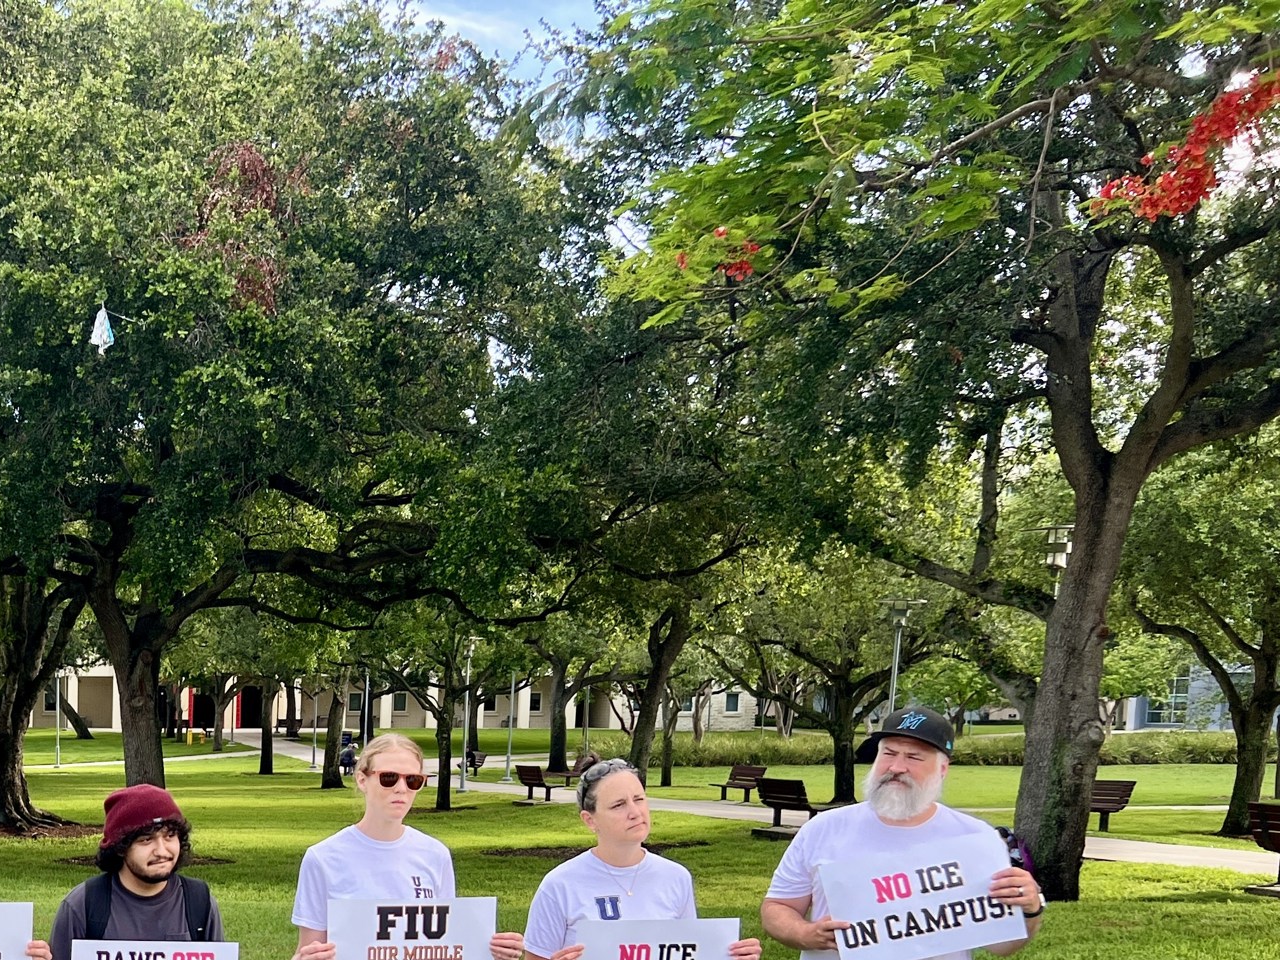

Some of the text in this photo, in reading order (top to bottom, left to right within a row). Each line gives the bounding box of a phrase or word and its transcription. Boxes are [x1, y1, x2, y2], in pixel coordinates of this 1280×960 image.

[414, 887, 433, 899] FIU
[872, 862, 964, 903] NO ICE
[376, 905, 450, 940] FIU
[594, 895, 621, 921] U
[842, 919, 879, 949] ON
